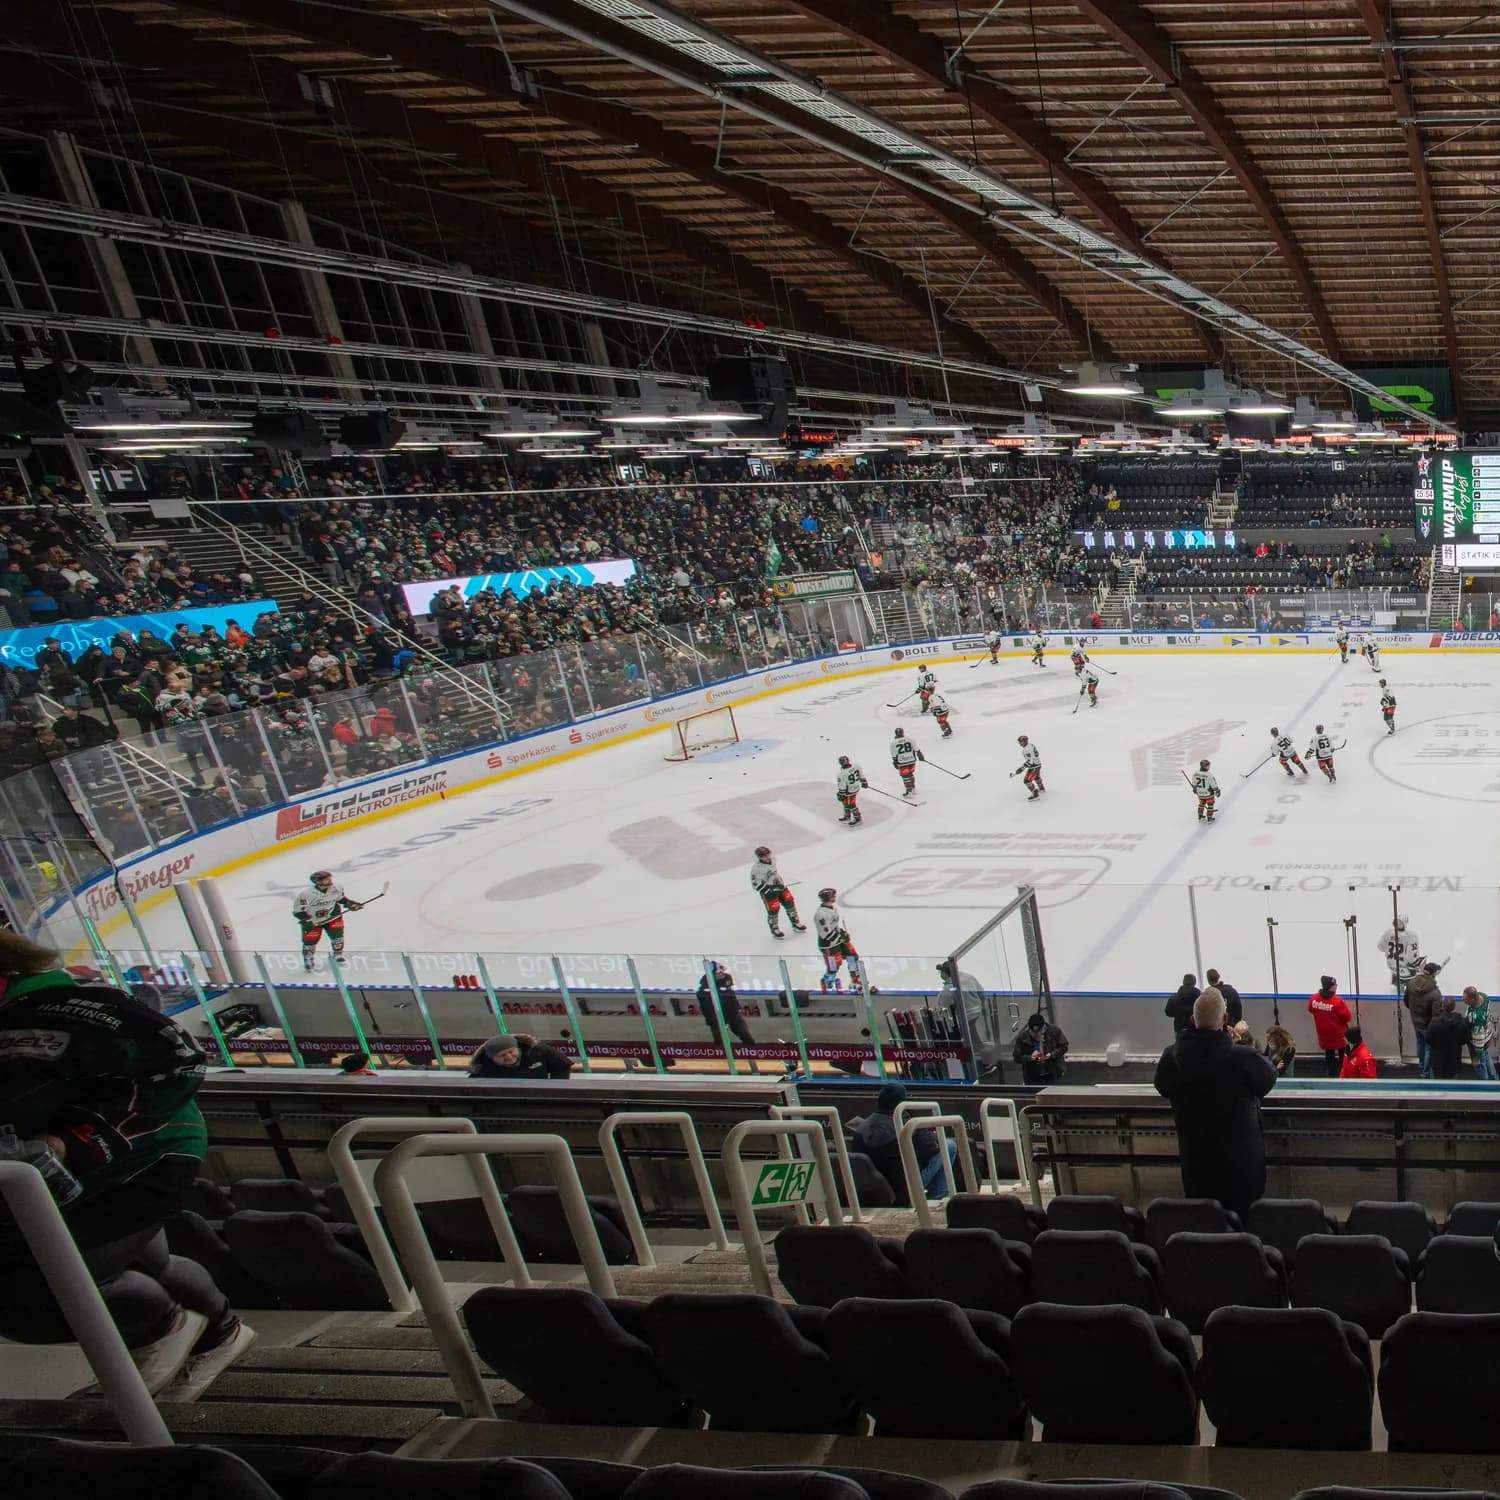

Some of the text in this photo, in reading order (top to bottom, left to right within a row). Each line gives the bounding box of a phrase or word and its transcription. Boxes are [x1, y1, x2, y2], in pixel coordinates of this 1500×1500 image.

[1416, 490, 1433, 498] 25:54
[1442, 459, 1456, 538] WARMUP
[1461, 551, 1490, 560] STATIK
[1131, 636, 1154, 645] MCP
[1177, 636, 1200, 645] MCP
[904, 645, 940, 656] BOLTE
[585, 722, 630, 741] Sparkasse
[896, 743, 913, 754] 28
[1278, 736, 1292, 750] 50
[1318, 737, 1330, 749] 63
[506, 743, 556, 764] Sparkasse
[848, 770, 860, 785] 93
[1195, 777, 1206, 789] 21
[331, 779, 448, 823] ELEKTROTECHNIK
[85, 852, 195, 925] Flözinger
[1345, 874, 1464, 893] Marc
[1312, 999, 1334, 1012] Ordner
[37, 1002, 123, 1028] HARTINGER
[228, 1042, 281, 1055] vitagroup
[299, 1042, 352, 1055] vitagroup
[370, 1042, 422, 1055] vitagroup
[587, 1046, 641, 1059] vitagroup
[661, 1046, 716, 1059] vitagroup
[734, 1048, 789, 1061] vitagroup
[809, 1048, 864, 1061] vitagroup
[893, 1050, 948, 1062] vitagroup
